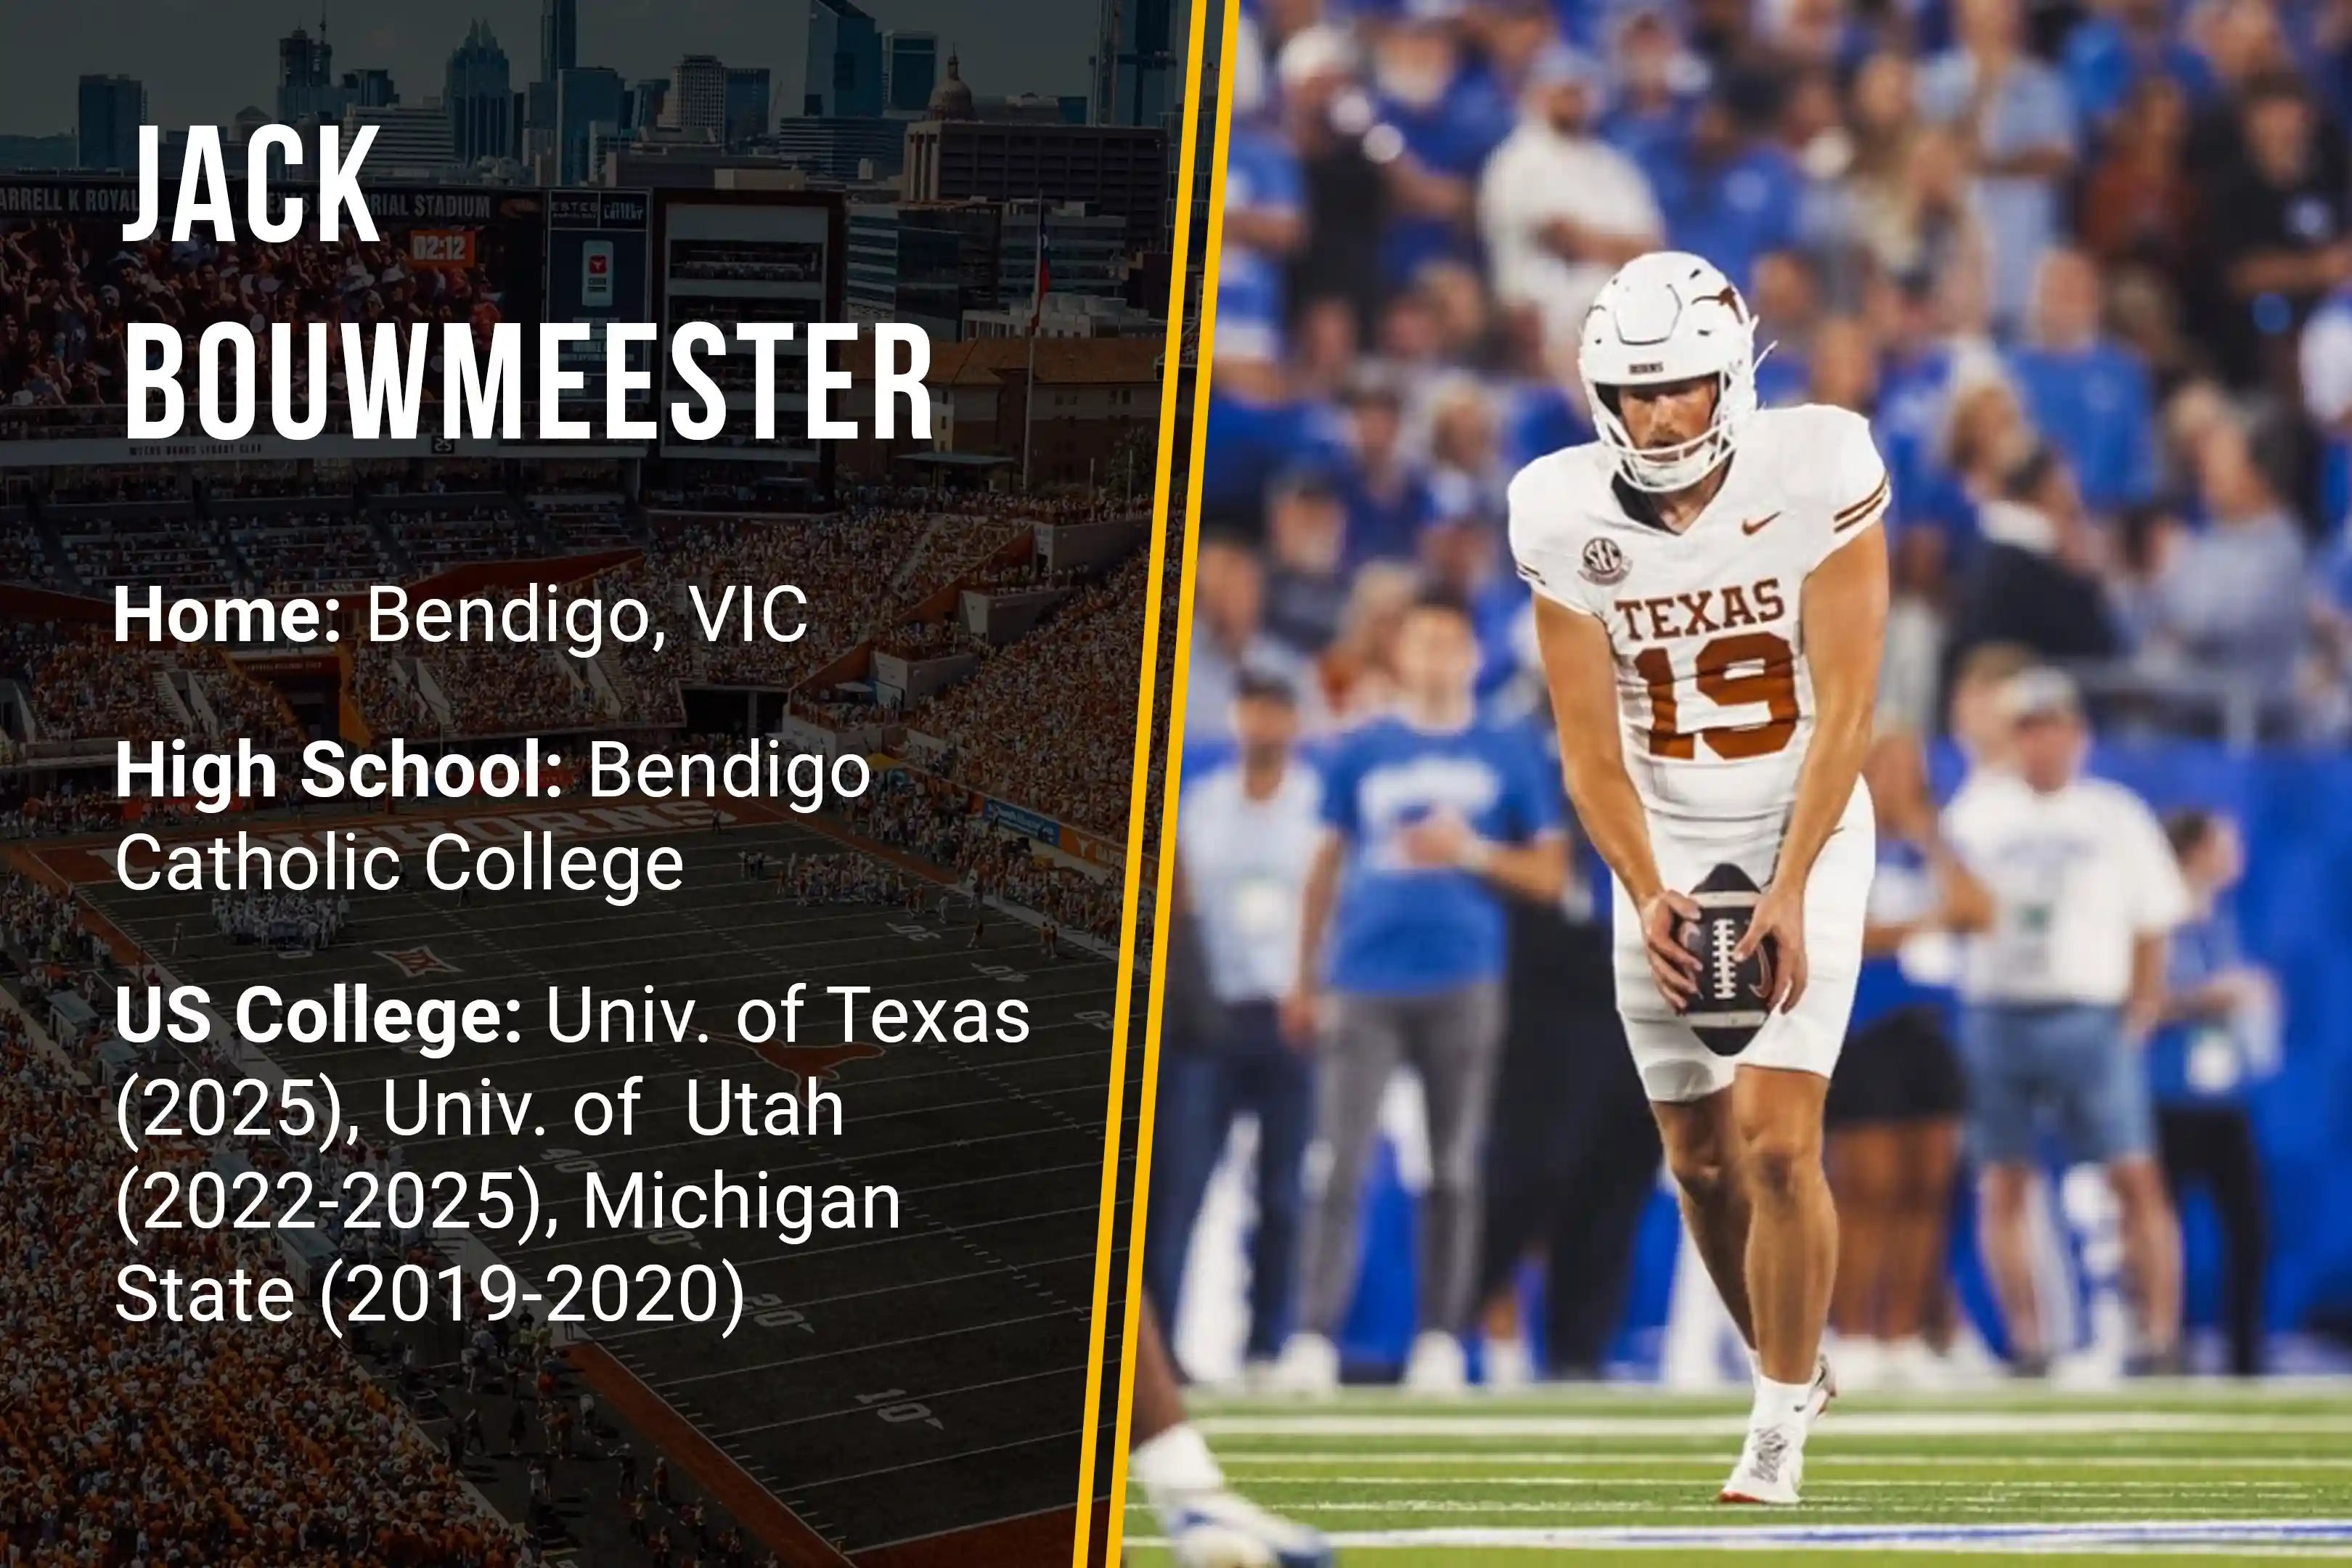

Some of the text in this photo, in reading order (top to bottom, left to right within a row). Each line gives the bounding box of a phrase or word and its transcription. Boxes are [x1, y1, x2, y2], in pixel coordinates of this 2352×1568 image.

[68, 189, 80, 211] K
[86, 189, 139, 212] ROYAL
[414, 195, 491, 219] STADIUM
[413, 236, 466, 260] 02:12
[1585, 540, 1622, 572] SEC
[1615, 579, 1785, 640] TEXAS
[1633, 631, 1800, 759] 19
[854, 1387, 931, 1424] 10
